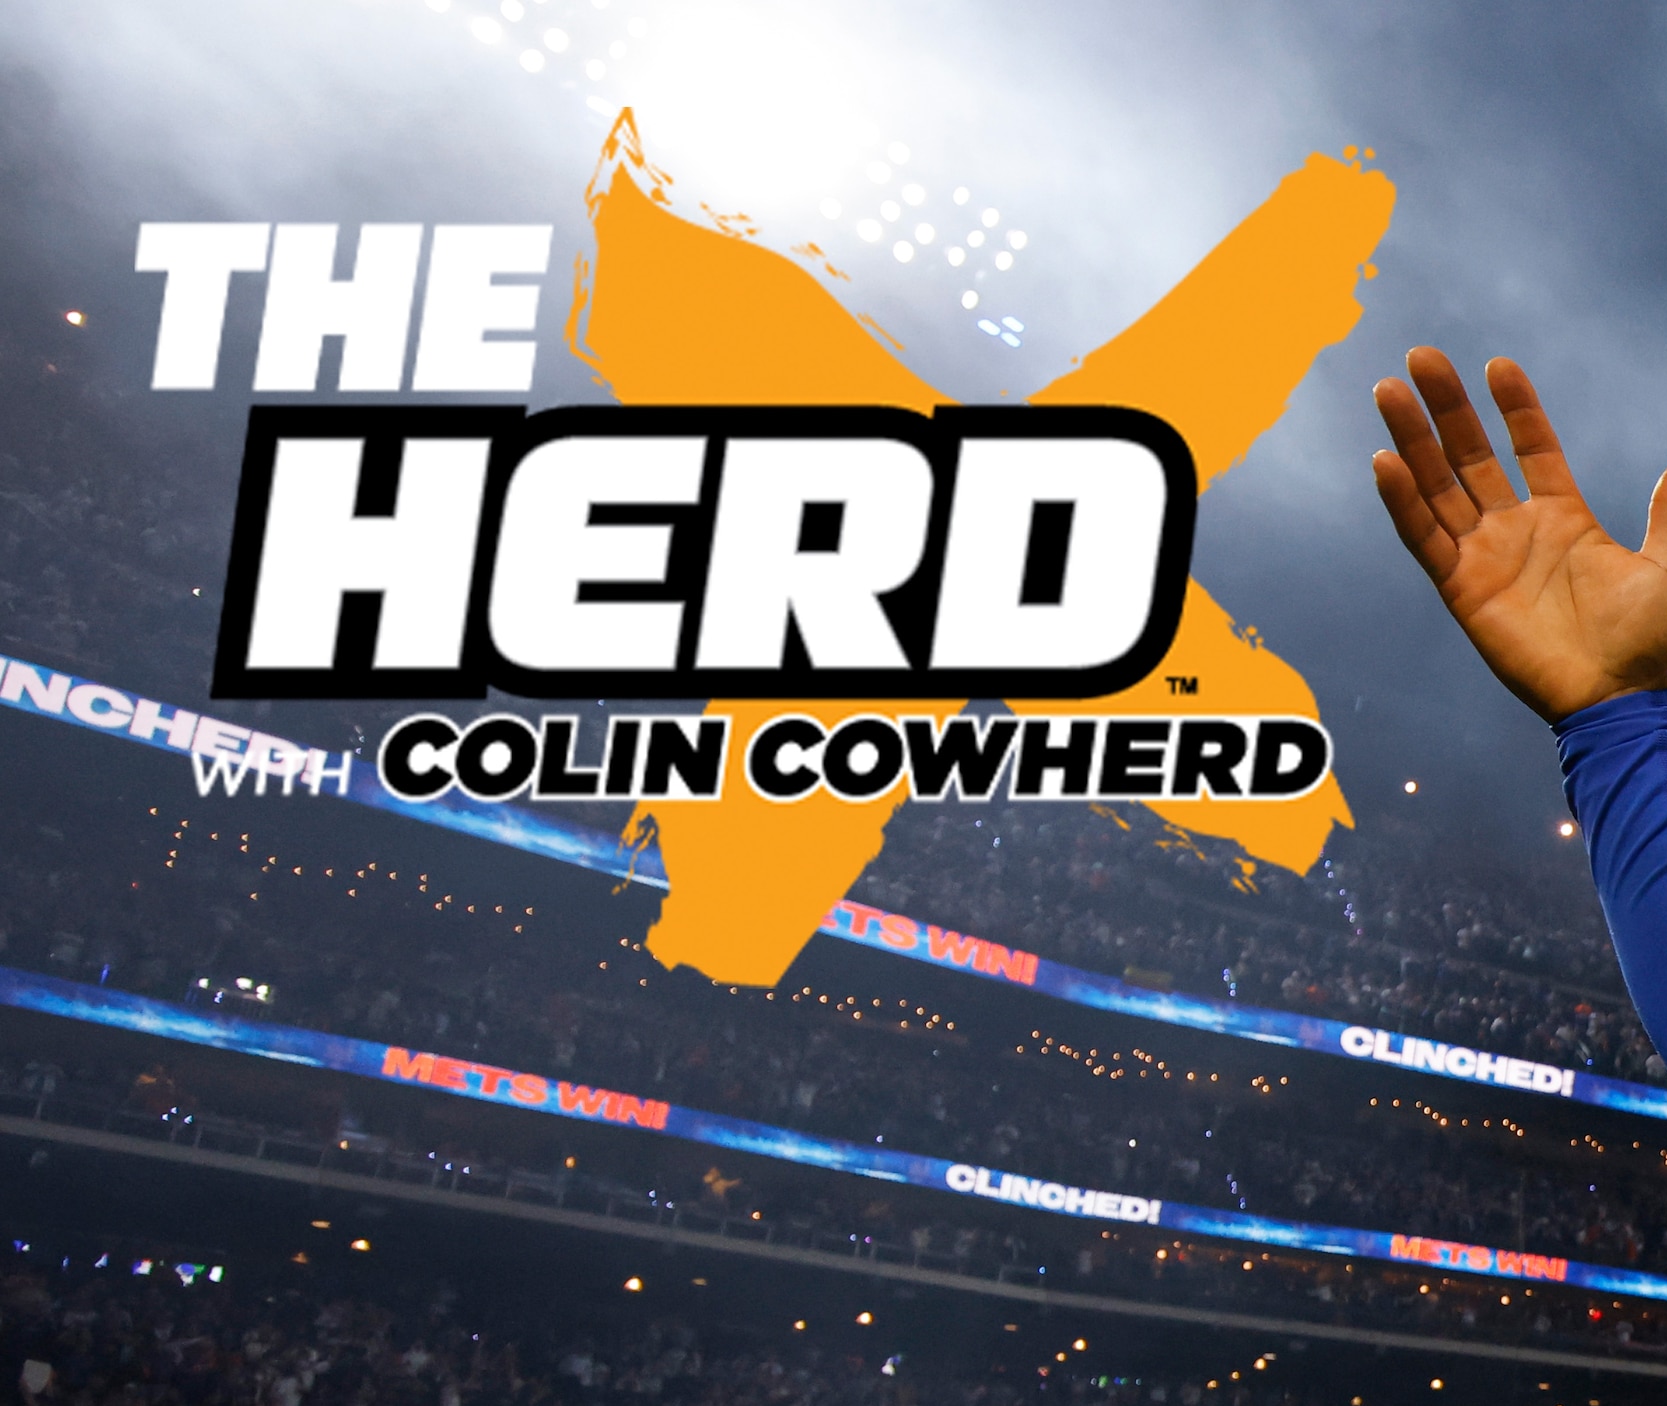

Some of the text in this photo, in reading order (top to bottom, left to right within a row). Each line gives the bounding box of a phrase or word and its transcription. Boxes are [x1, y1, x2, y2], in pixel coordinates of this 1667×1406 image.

[927, 924, 1039, 986] WIN!
[382, 1046, 670, 1130] METS WIN!
[1340, 1026, 1575, 1097] CLINCHED!
[946, 1164, 1162, 1225] CLINCHED!
[1390, 1234, 1492, 1270] METS
